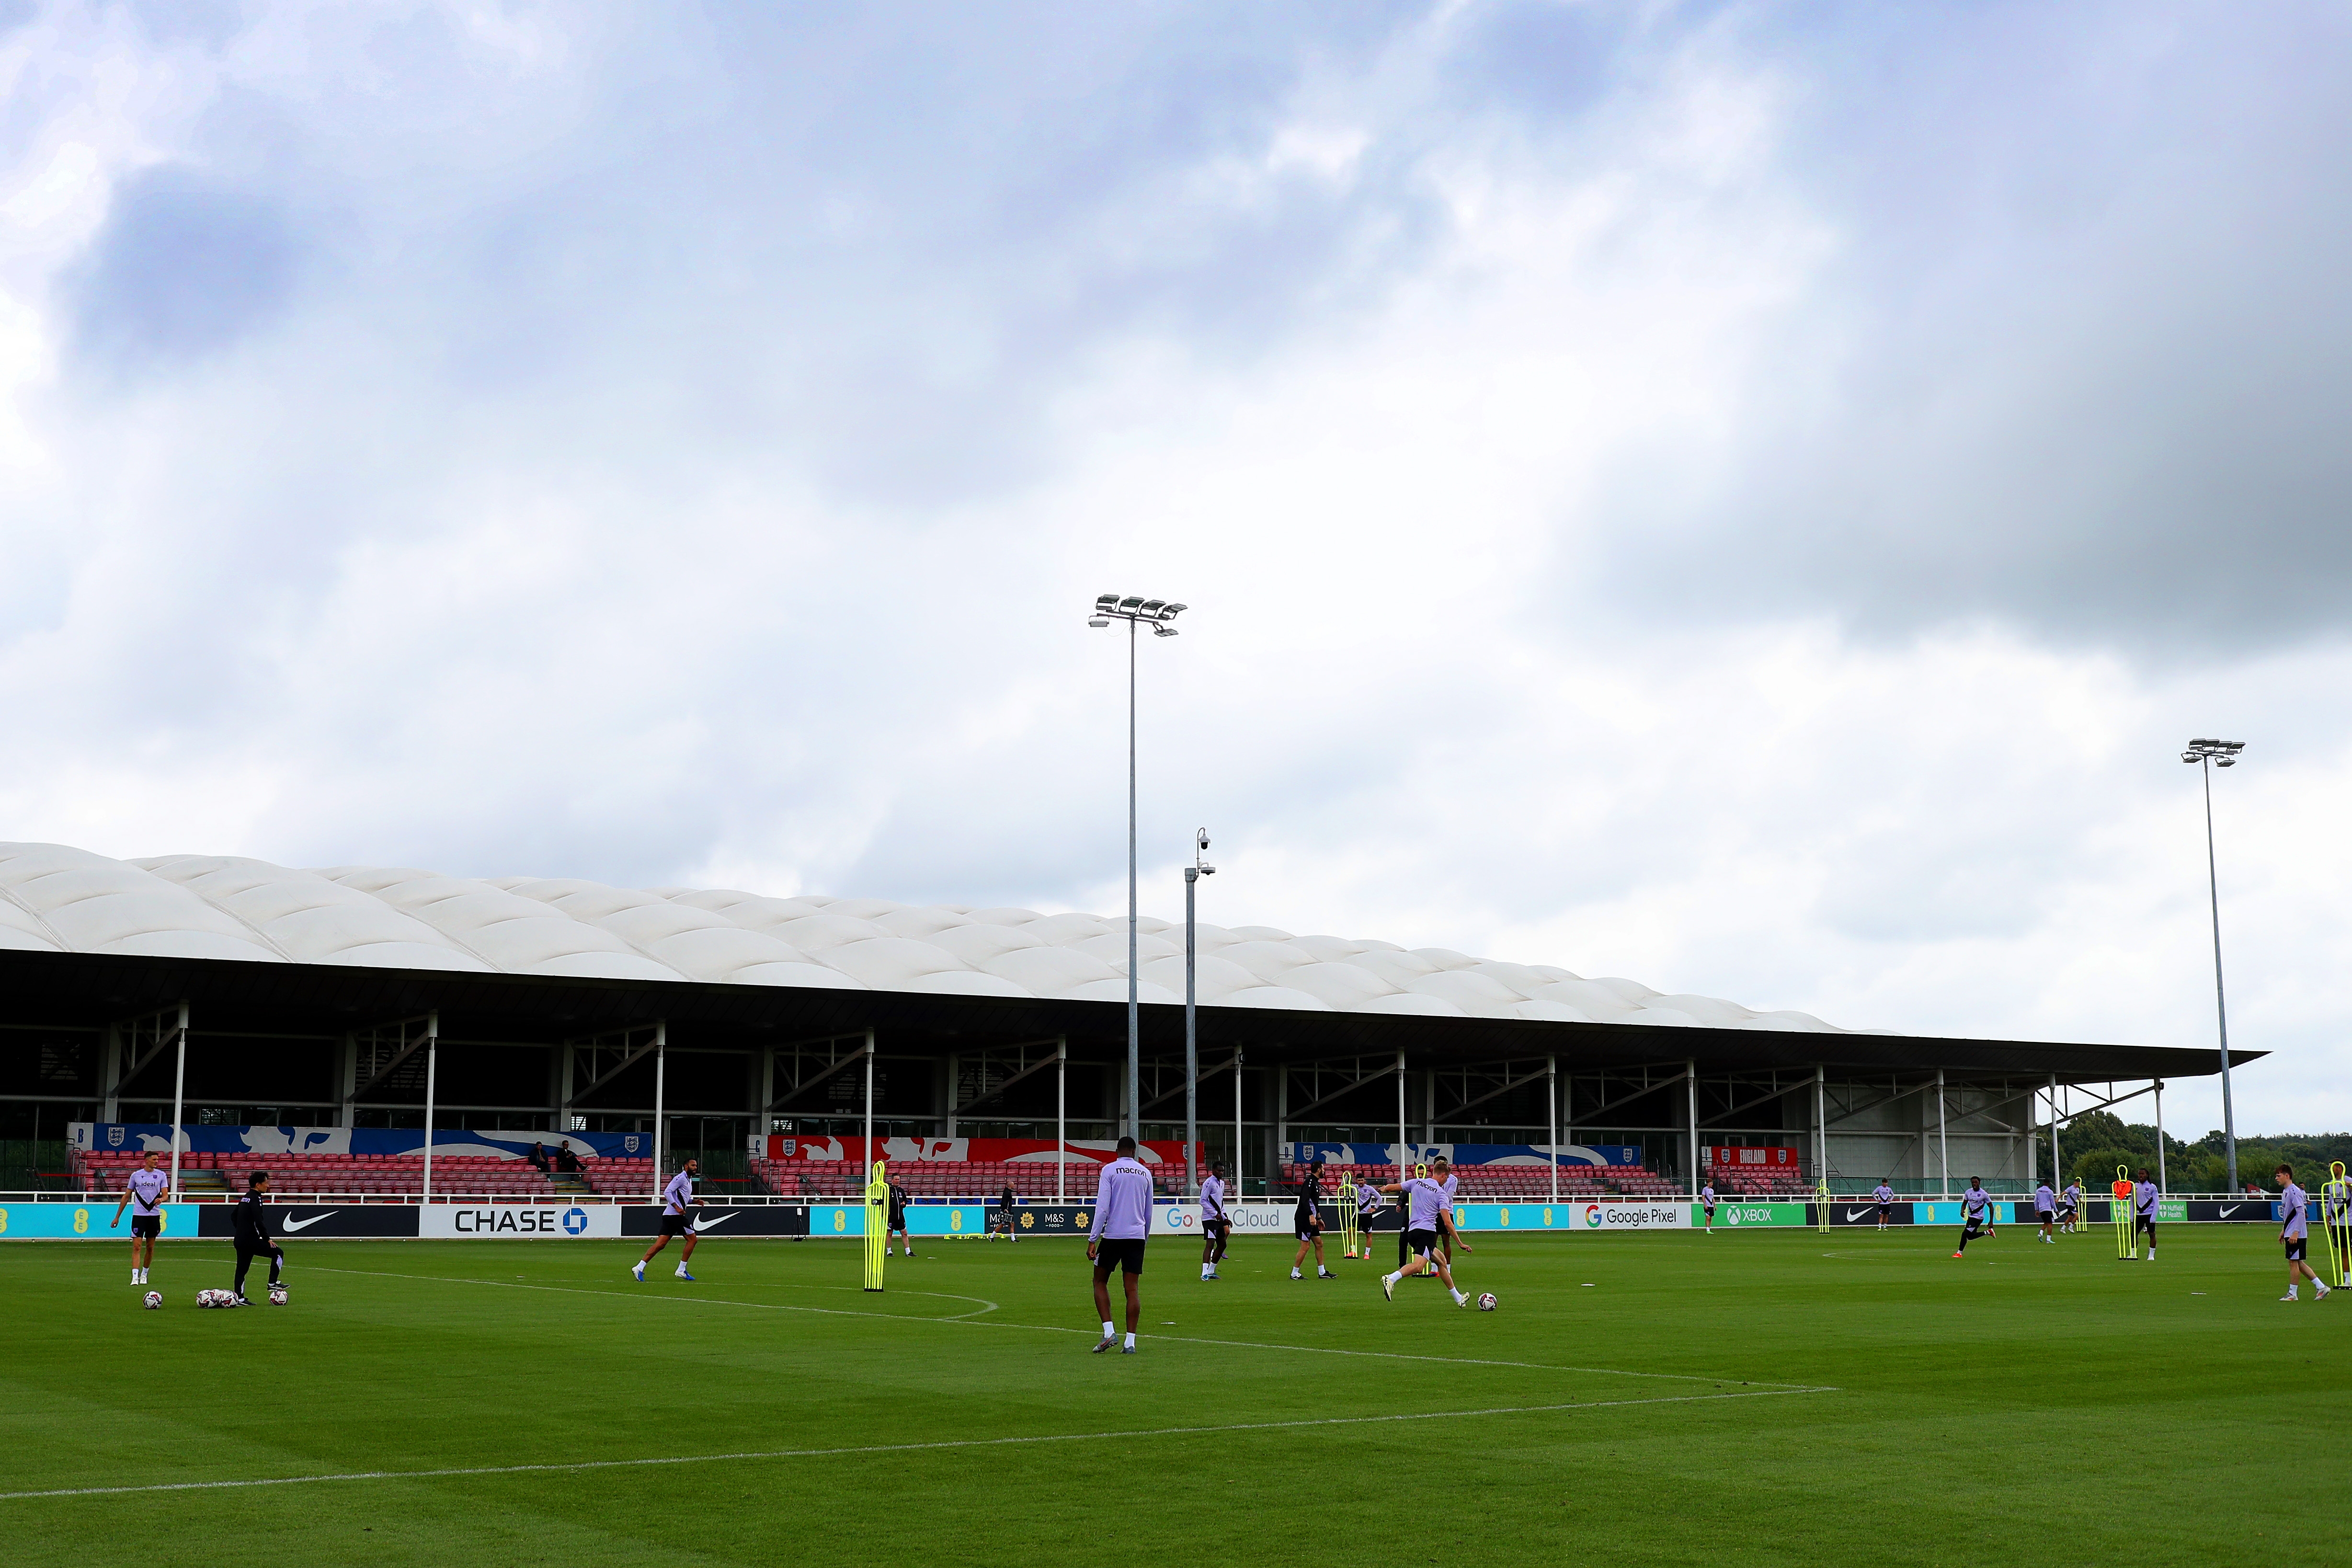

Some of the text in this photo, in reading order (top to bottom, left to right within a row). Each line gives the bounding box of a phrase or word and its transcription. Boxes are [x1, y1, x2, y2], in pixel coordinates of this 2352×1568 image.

[78, 1128, 84, 1143] B
[1740, 1149, 1766, 1164] ENGLAND
[1116, 1167, 1147, 1177] macron
[1416, 1180, 1438, 1193] macron
[455, 1211, 556, 1232] CHASE
[1045, 1213, 1064, 1223] M&S
[1233, 1209, 1279, 1227] Cloud
[1607, 1209, 1648, 1226] Google
[1651, 1209, 1676, 1223] Pixel
[1743, 1209, 1772, 1221] XBOX
